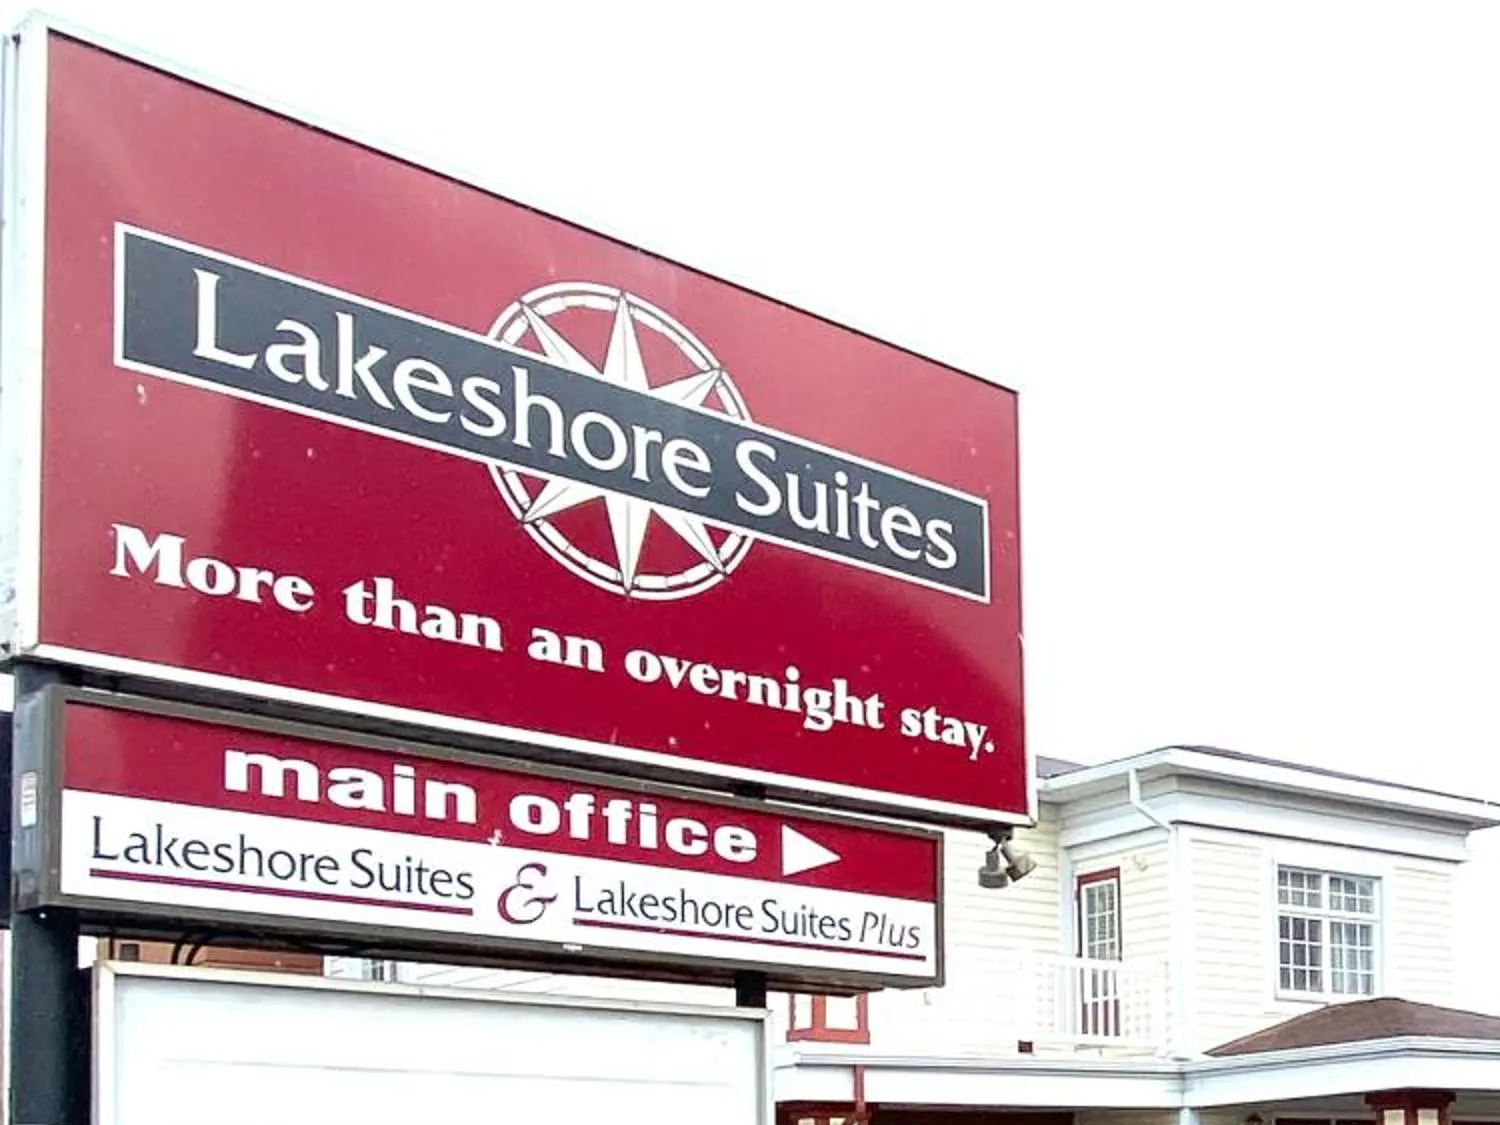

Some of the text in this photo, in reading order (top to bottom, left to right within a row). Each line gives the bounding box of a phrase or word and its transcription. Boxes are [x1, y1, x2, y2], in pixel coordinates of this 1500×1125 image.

[193, 269, 958, 570] Lakeshore Suites
[110, 524, 995, 758] More than an overnight stay.
[91, 816, 922, 950] Lakeshore Suites & Lakeshore Suites Plus
[224, 749, 758, 864] main office
